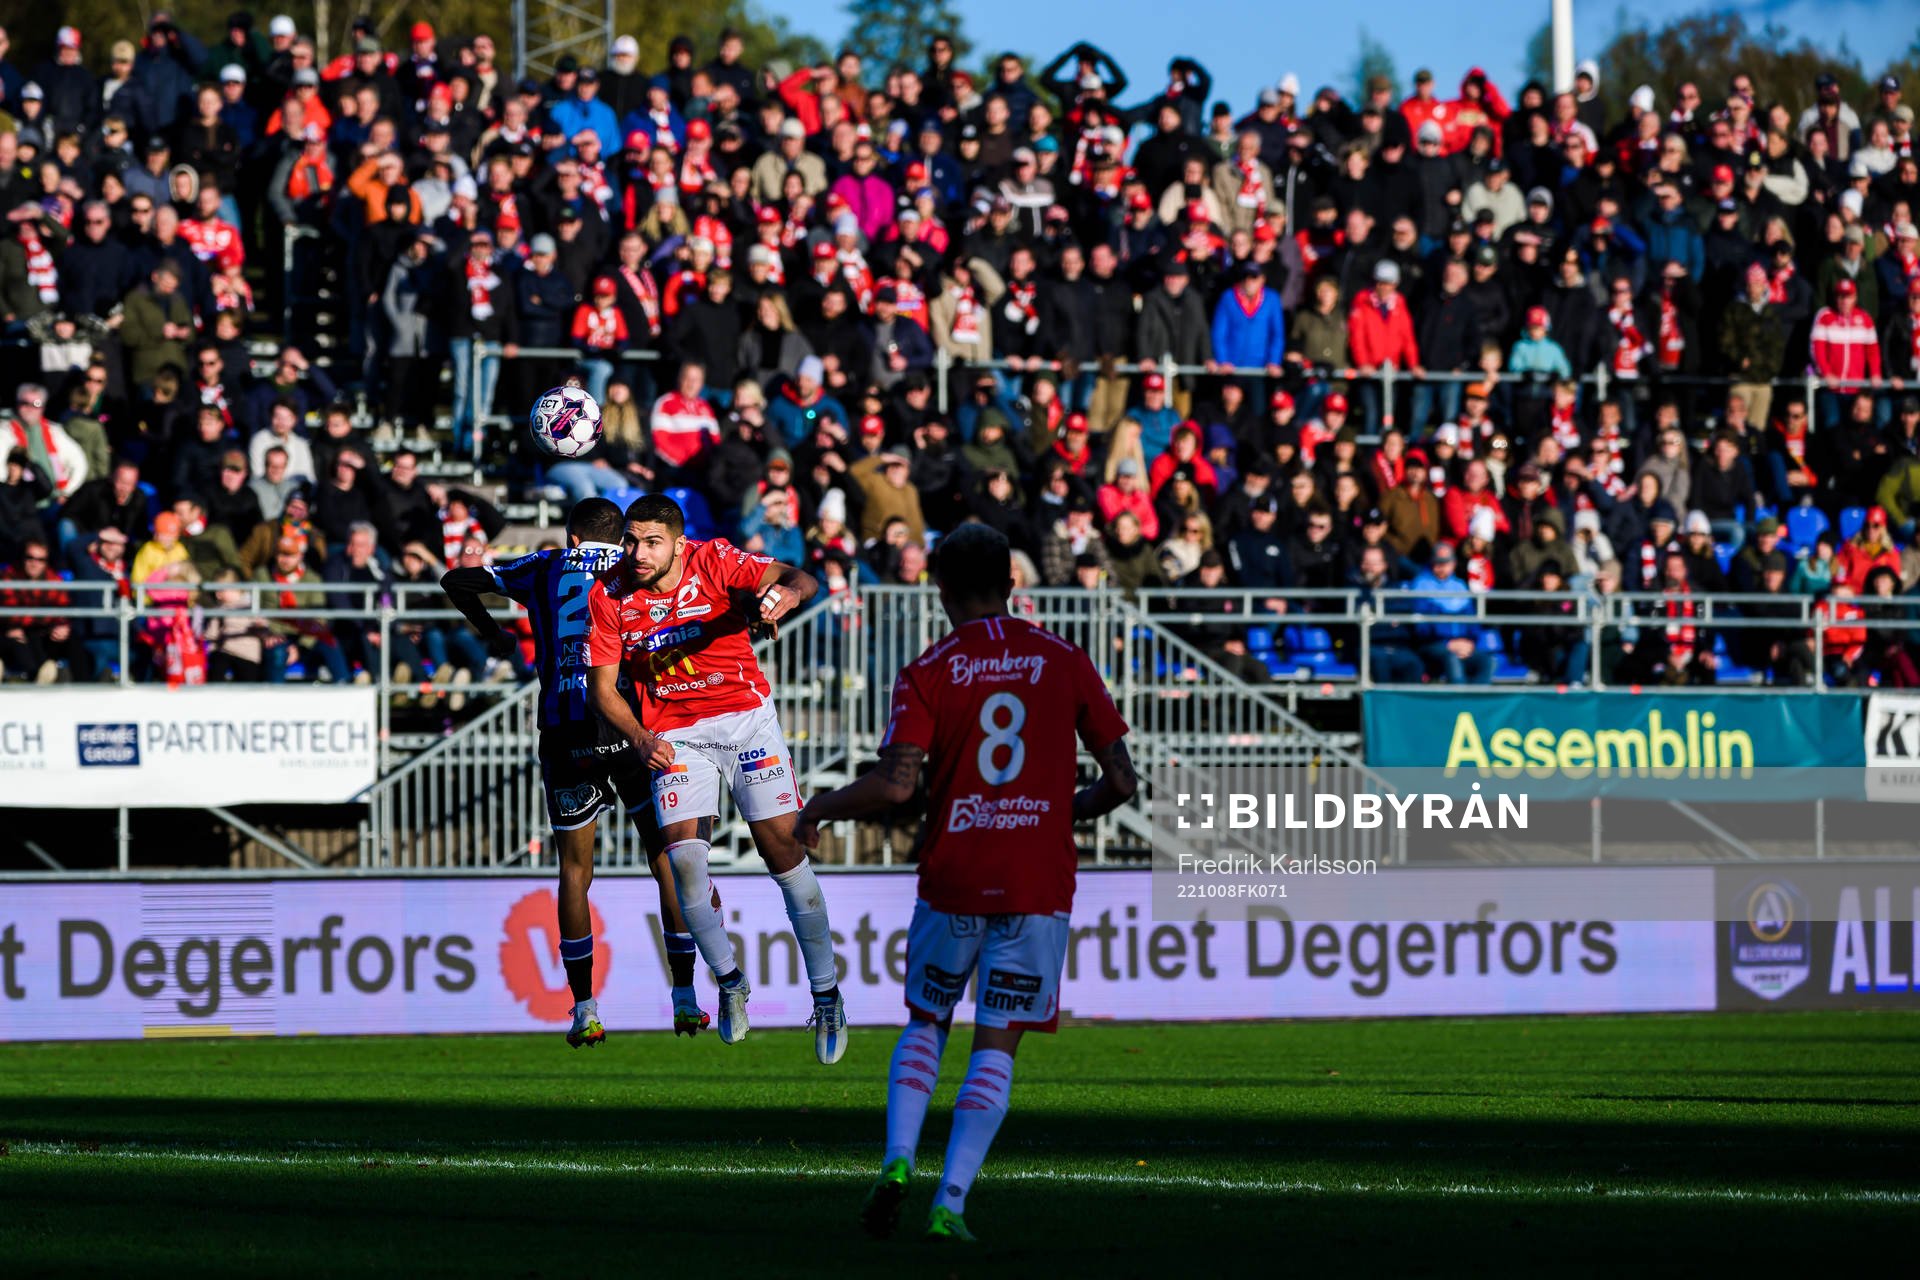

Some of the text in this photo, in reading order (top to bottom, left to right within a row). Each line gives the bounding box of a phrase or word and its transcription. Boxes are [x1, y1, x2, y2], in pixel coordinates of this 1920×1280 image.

[948, 648, 1047, 687] Björnberg
[0, 722, 44, 755] CH
[147, 720, 368, 753] PARTNERTECH
[977, 692, 1026, 786] 8
[1443, 709, 1755, 779] Assemblin
[83, 746, 135, 762] GROUP
[738, 748, 766, 762] CEOS
[744, 766, 785, 784] D-LAB
[659, 791, 678, 810] 19
[975, 813, 1040, 829] Byggen
[58, 915, 477, 1018] Degerfors
[1246, 902, 1618, 998] Degerfors
[983, 988, 1036, 1012] EMPE
